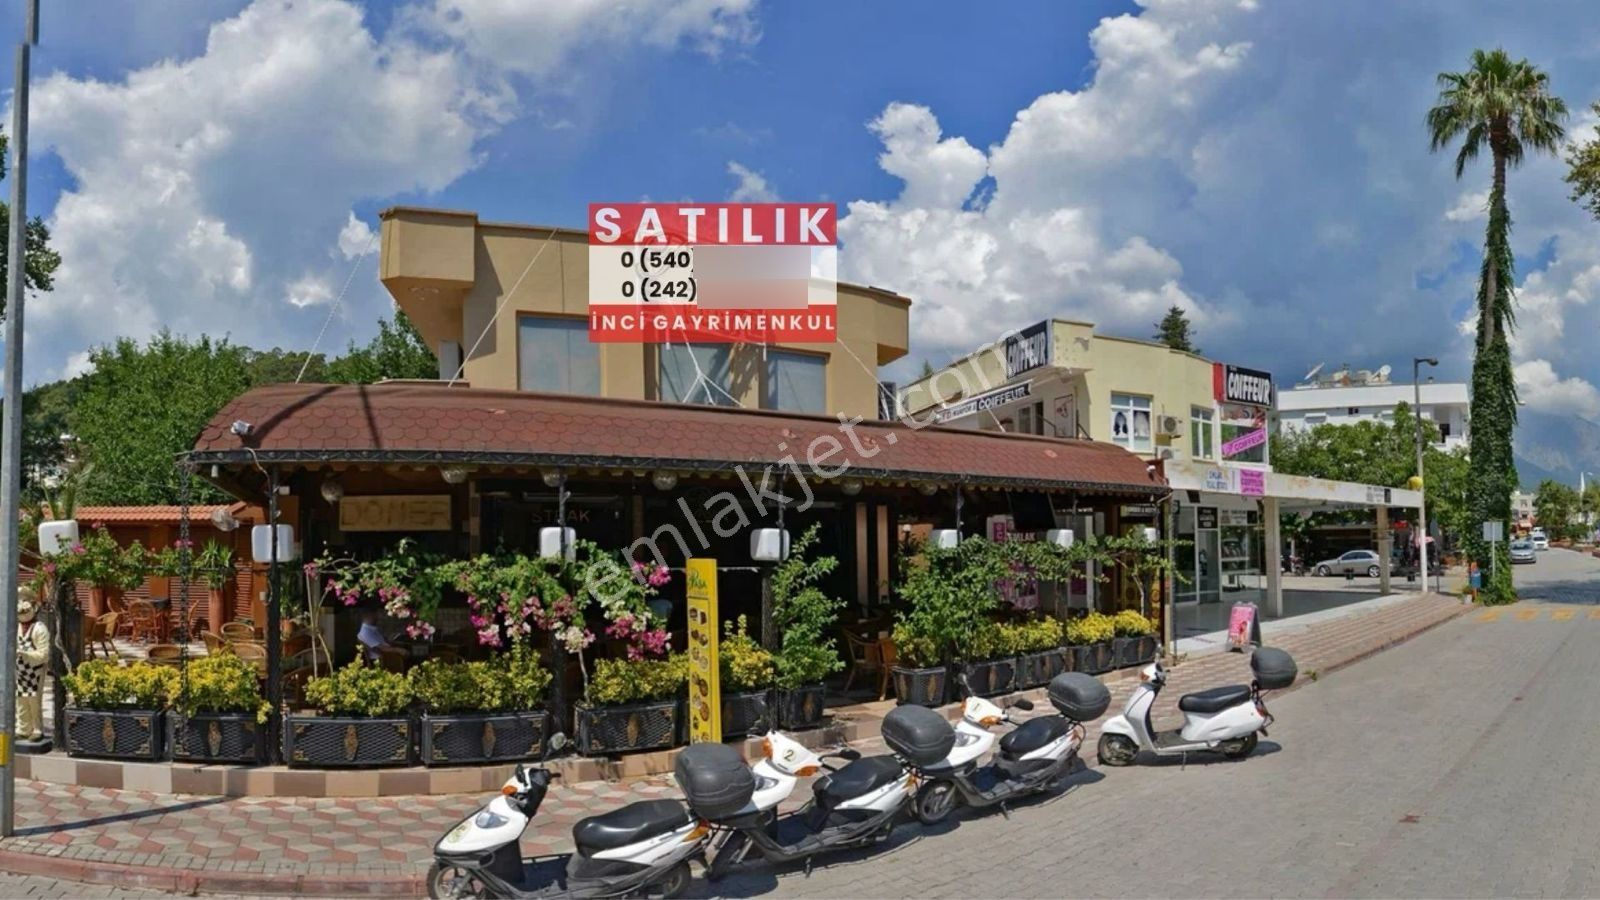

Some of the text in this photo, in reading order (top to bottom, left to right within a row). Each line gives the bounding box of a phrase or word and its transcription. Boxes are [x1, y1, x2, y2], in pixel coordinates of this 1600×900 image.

[1229, 371, 1270, 405] COIFFEUR
[979, 387, 1026, 410] COIFFEUR
[532, 508, 591, 524] STAK
[784, 749, 794, 762] 2
